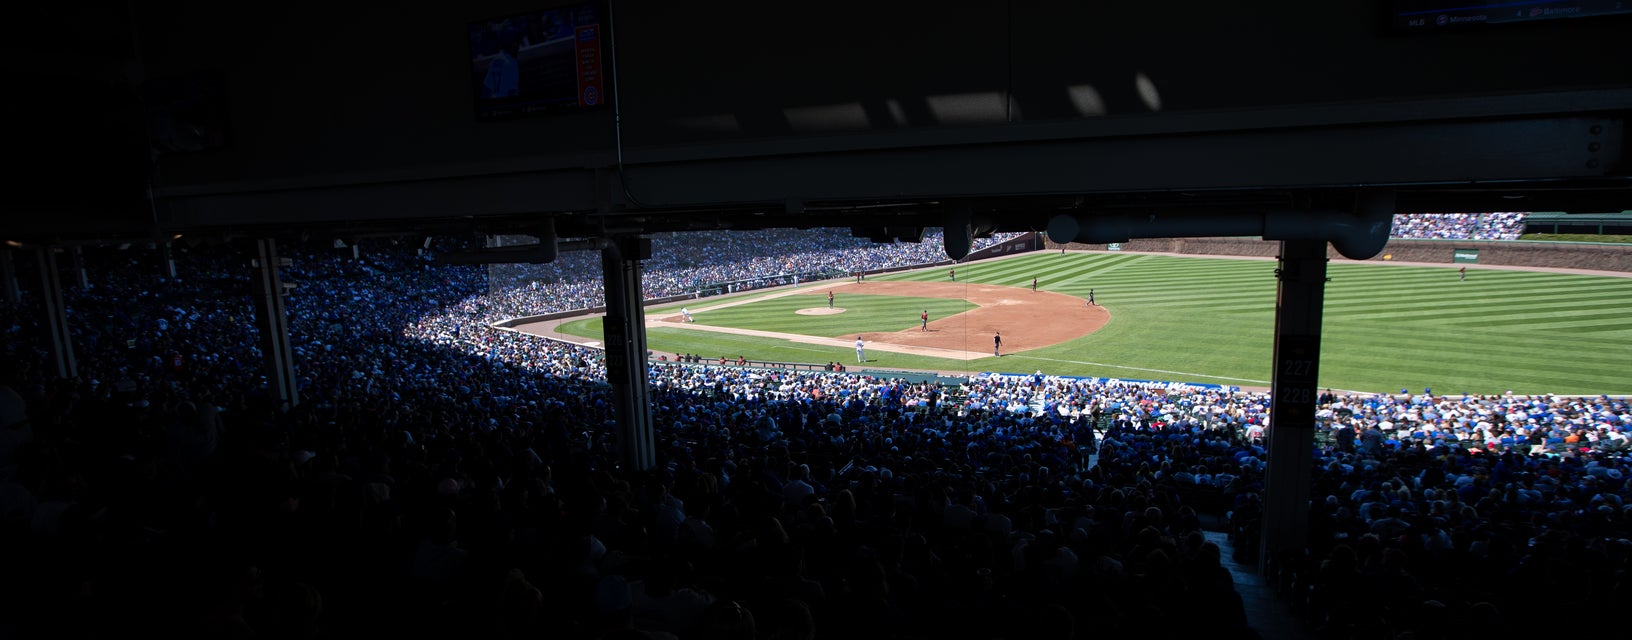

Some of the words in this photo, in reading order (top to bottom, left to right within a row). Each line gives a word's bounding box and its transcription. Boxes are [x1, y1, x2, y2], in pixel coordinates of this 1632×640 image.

[1450, 15, 1488, 23] Minnesota
[1544, 6, 1582, 16] Baltimore
[1284, 360, 1312, 376] 227
[1282, 387, 1310, 403] 228
